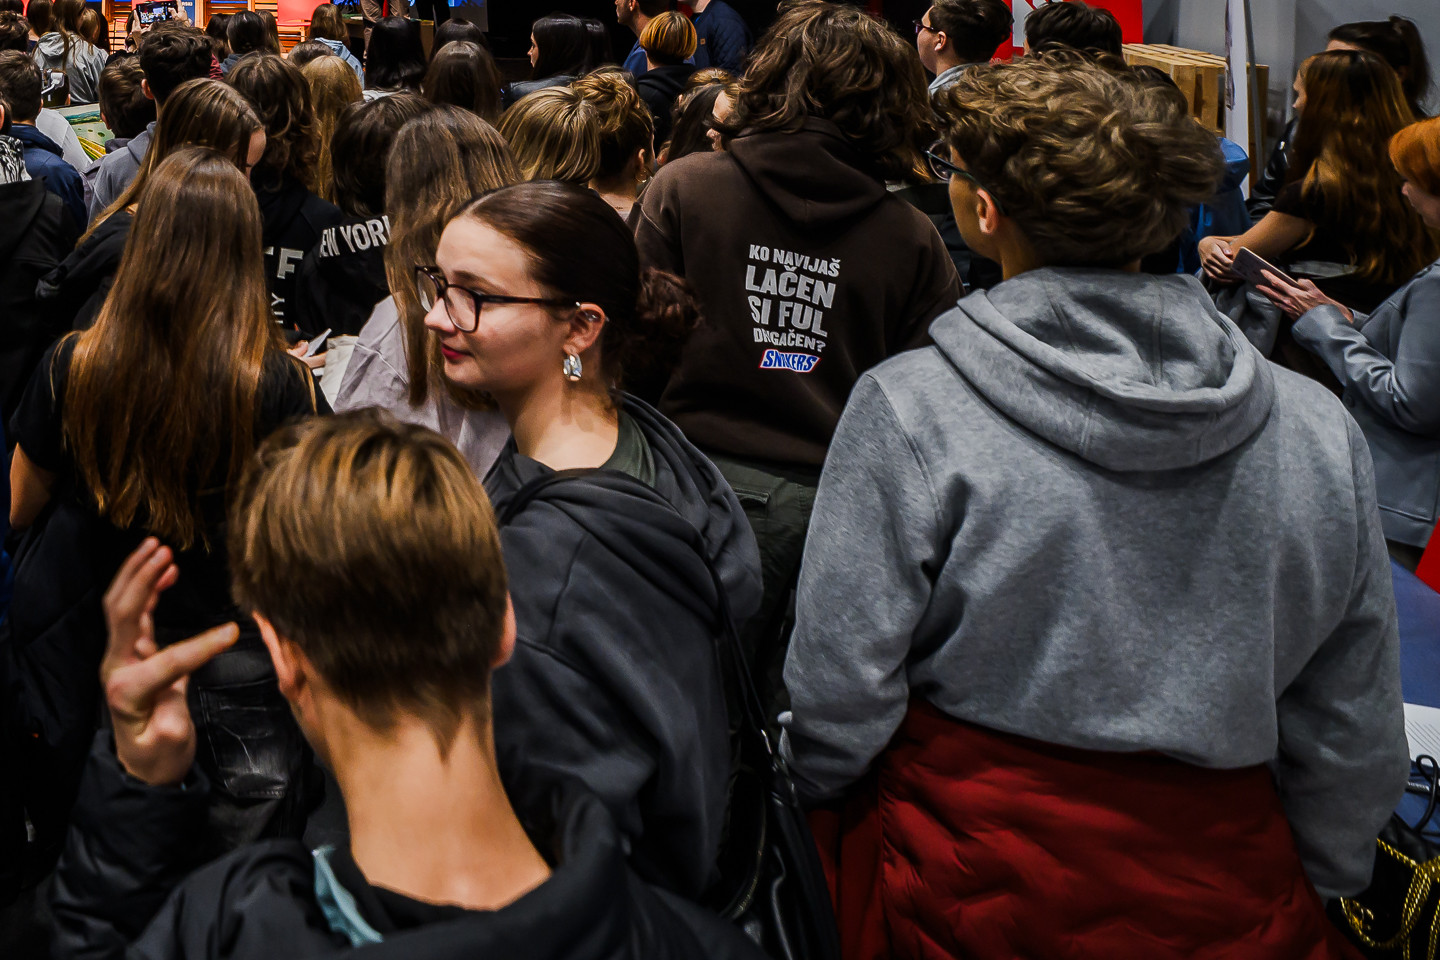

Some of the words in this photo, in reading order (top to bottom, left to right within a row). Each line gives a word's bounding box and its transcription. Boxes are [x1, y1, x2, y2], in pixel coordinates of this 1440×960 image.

[319, 227, 340, 258] EW
[263, 245, 304, 279] F
[749, 244, 770, 262] KO
[772, 248, 841, 278] NAVIJAŠ
[745, 264, 837, 309] LAČEN
[747, 295, 772, 325] SI
[778, 300, 828, 338] FUL
